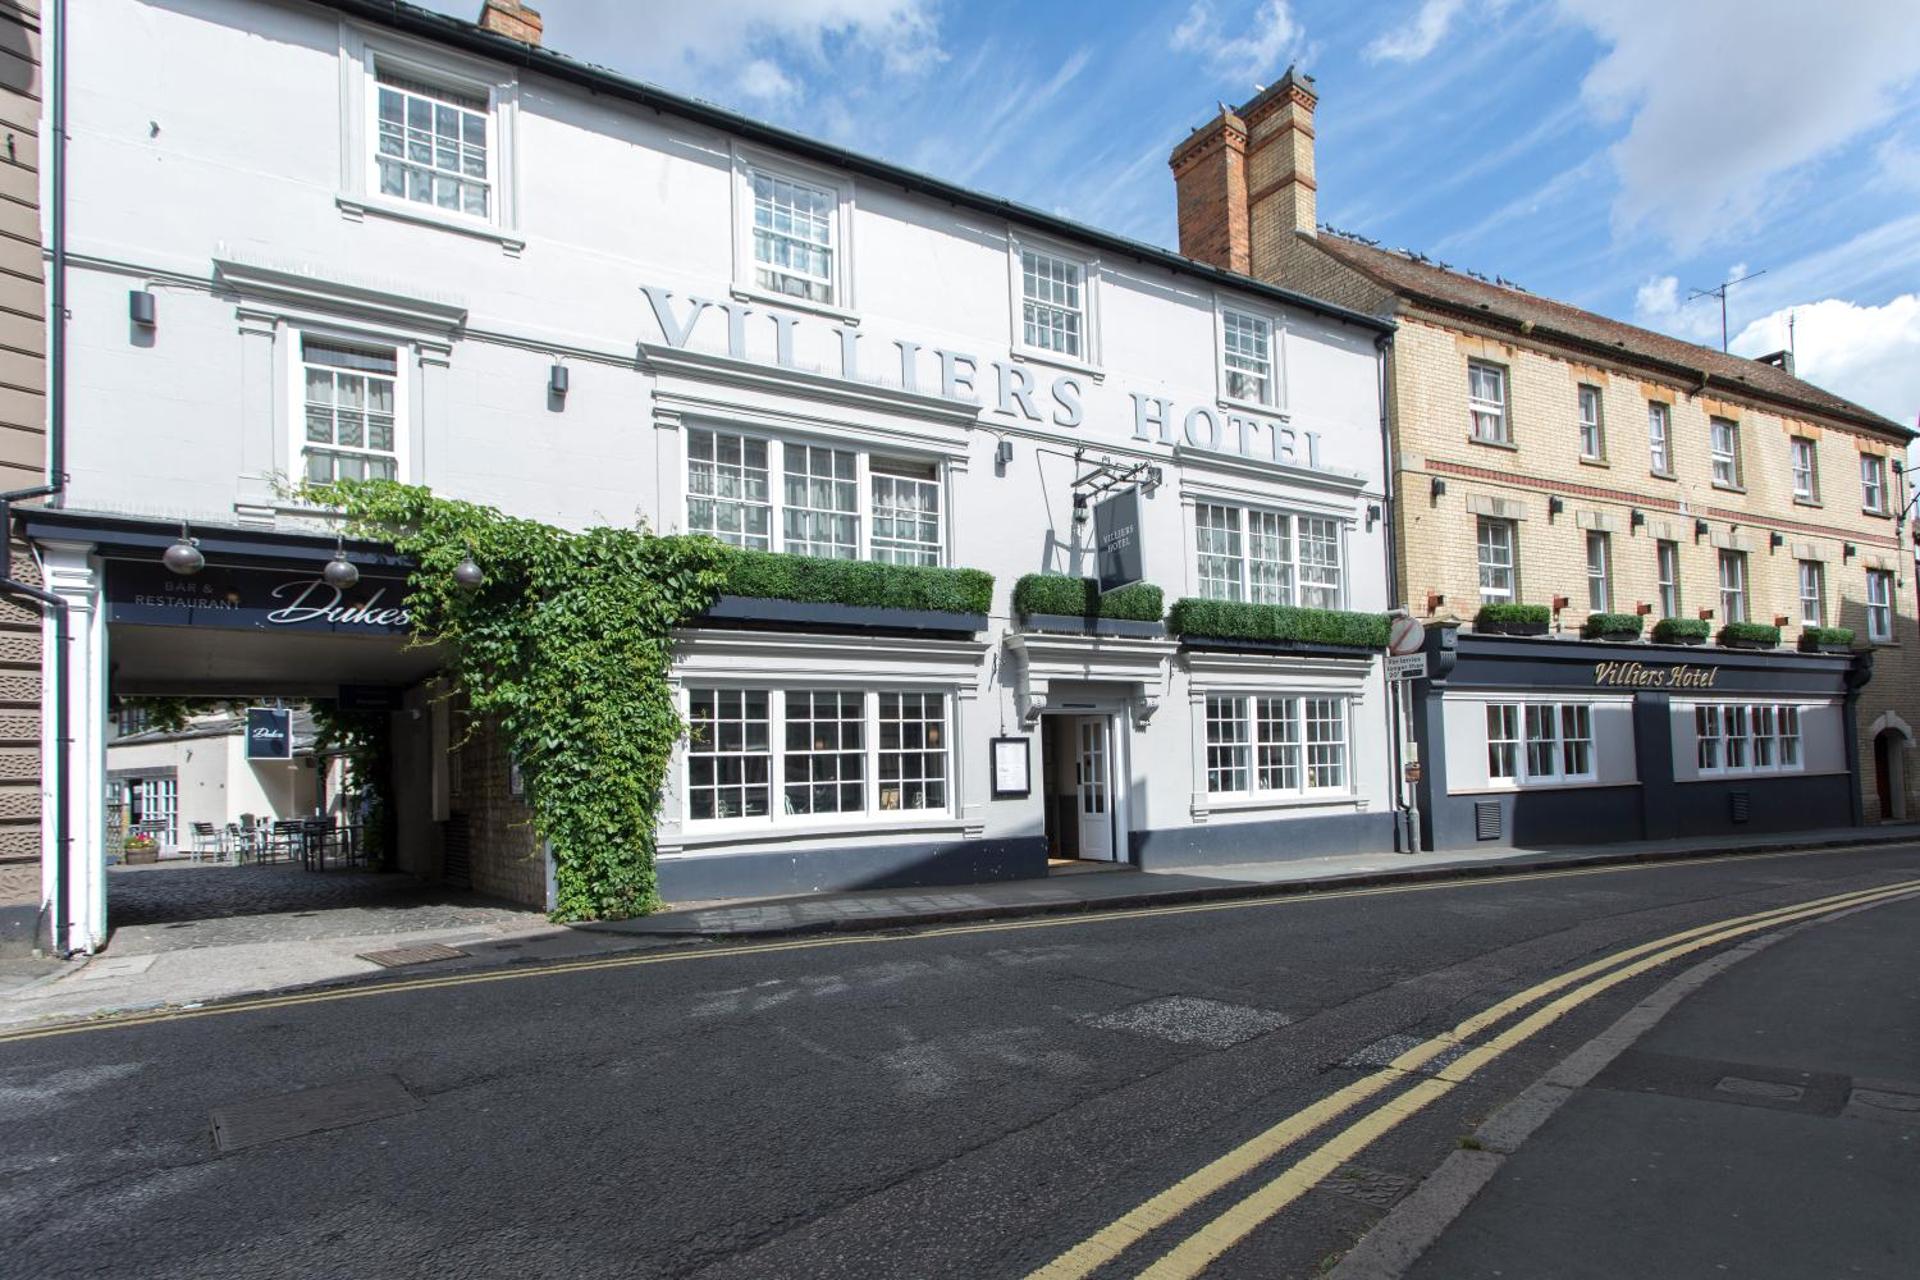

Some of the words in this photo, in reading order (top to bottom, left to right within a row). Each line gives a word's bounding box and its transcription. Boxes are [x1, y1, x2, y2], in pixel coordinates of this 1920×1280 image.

[638, 286, 1085, 428] VILLIERS
[1128, 392, 1322, 469] HOTEL
[1103, 524, 1134, 543] VILLIERS
[1107, 537, 1131, 553] HOTEL
[164, 581, 196, 593] BAR
[202, 583, 214, 594] &
[134, 594, 240, 610] RESTAURANT
[267, 578, 412, 626] Dukes
[1595, 661, 1665, 687] Villiers
[1666, 664, 1719, 688] Hotel
